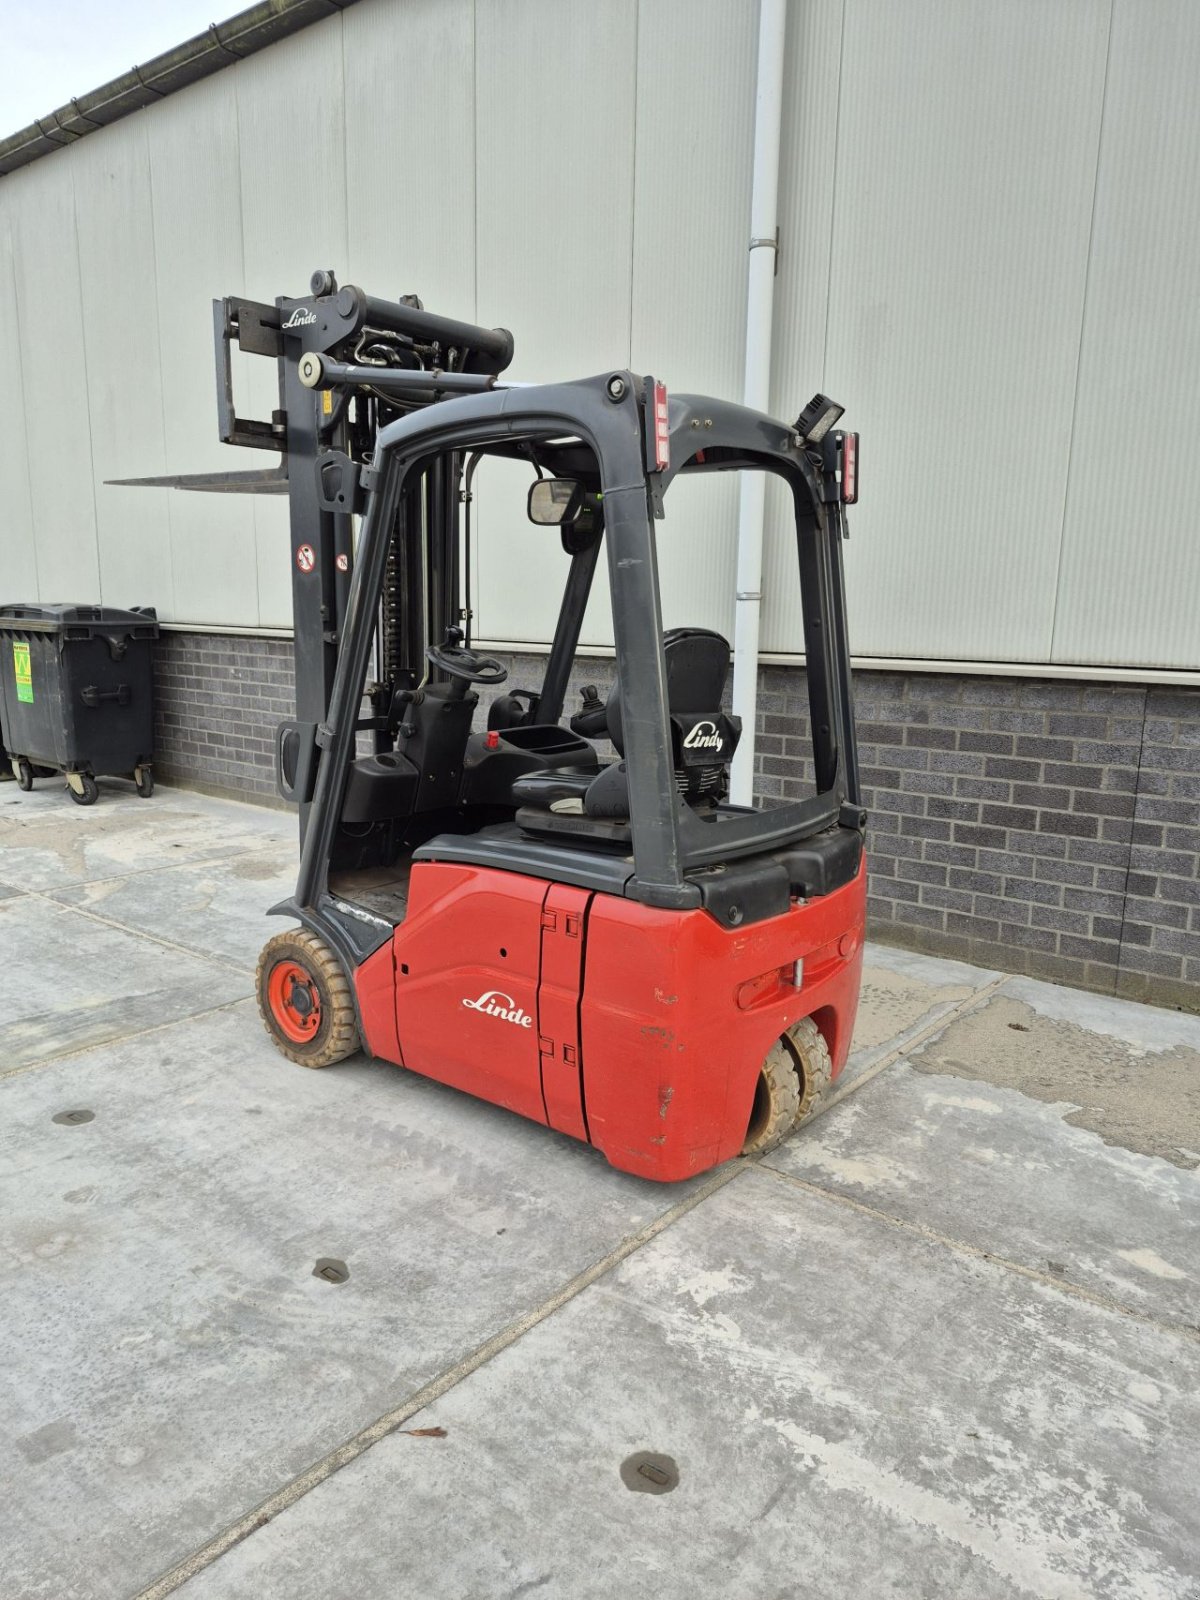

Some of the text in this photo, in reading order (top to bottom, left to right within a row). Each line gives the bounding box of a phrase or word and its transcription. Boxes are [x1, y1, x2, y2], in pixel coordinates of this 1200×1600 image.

[282, 307, 317, 328] Linde
[683, 721, 723, 752] Lindy
[462, 991, 532, 1028] Linde
